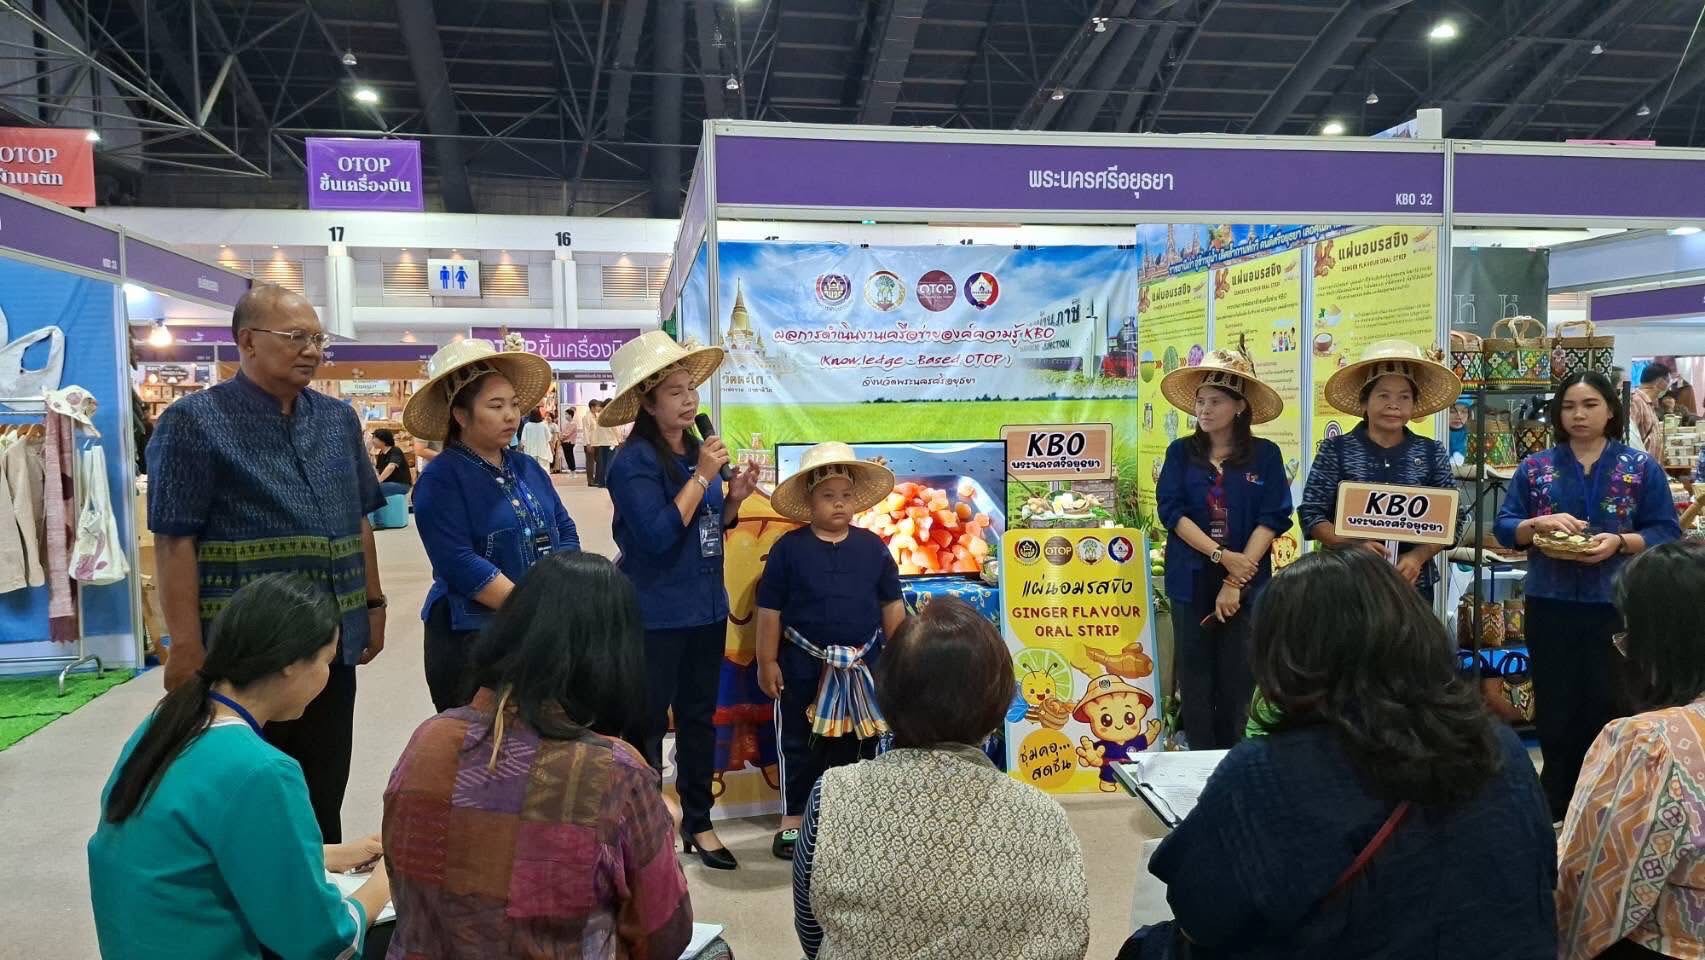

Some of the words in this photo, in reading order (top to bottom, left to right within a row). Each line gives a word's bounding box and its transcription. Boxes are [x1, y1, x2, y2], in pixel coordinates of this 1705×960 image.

[0, 146, 58, 164] OTOP
[338, 156, 391, 172] OTOP
[319, 172, 412, 193] ขึ้นเครื่องบิน
[1028, 167, 1174, 198] พระนครศรีอยุธยา
[1395, 193, 1416, 206] KBO
[1420, 193, 1433, 206] 32
[328, 226, 345, 243] 17
[555, 231, 572, 247] 16
[1338, 231, 1409, 261] แผ่นอมรสขิง
[1231, 262, 1282, 286] แผ่นอมรสขิง
[917, 283, 954, 296] OTOP
[1024, 327, 1055, 339] KBO
[539, 334, 624, 358] ขึ้นเครื่องบิ
[918, 353, 961, 365] Based
[1026, 432, 1086, 457] KBO
[1011, 456, 1101, 472] พระนครศรีอยุธยา
[1364, 492, 1430, 519] KBO
[1347, 516, 1444, 535] พระนครศรีอยุธยา
[1045, 546, 1073, 556] OTOP
[1022, 573, 1133, 597] แผ่นอมรสขิง
[1012, 606, 1069, 619] GINGER
[1072, 605, 1141, 618] FLAVOUR
[1035, 625, 1073, 638] ORAL
[1078, 624, 1120, 637] STRIP
[1032, 751, 1072, 781] สดชื่น
